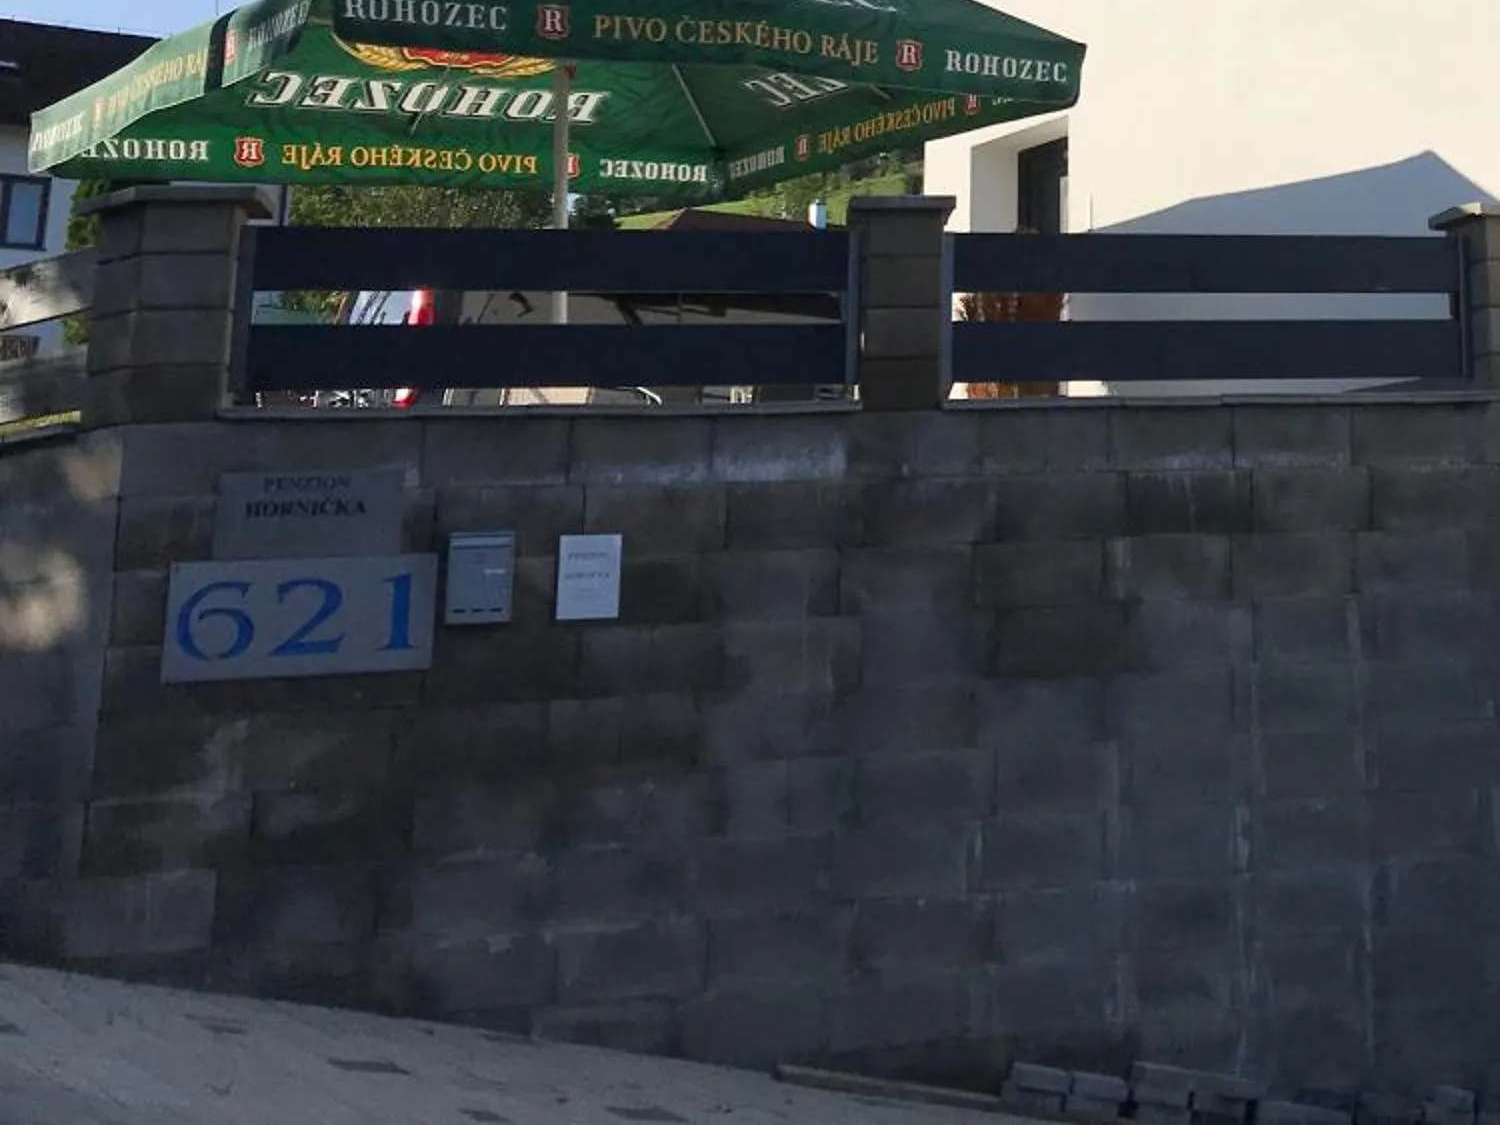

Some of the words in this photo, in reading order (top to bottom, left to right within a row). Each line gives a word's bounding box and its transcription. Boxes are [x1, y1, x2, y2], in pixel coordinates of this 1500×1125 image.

[594, 14, 668, 43] PIVO
[676, 13, 812, 55] ČESKÉHO
[820, 31, 878, 67] RÁJE
[944, 48, 1069, 84] ROHOZEC
[245, 498, 367, 518] HORNIČKA
[175, 572, 419, 662] 621
